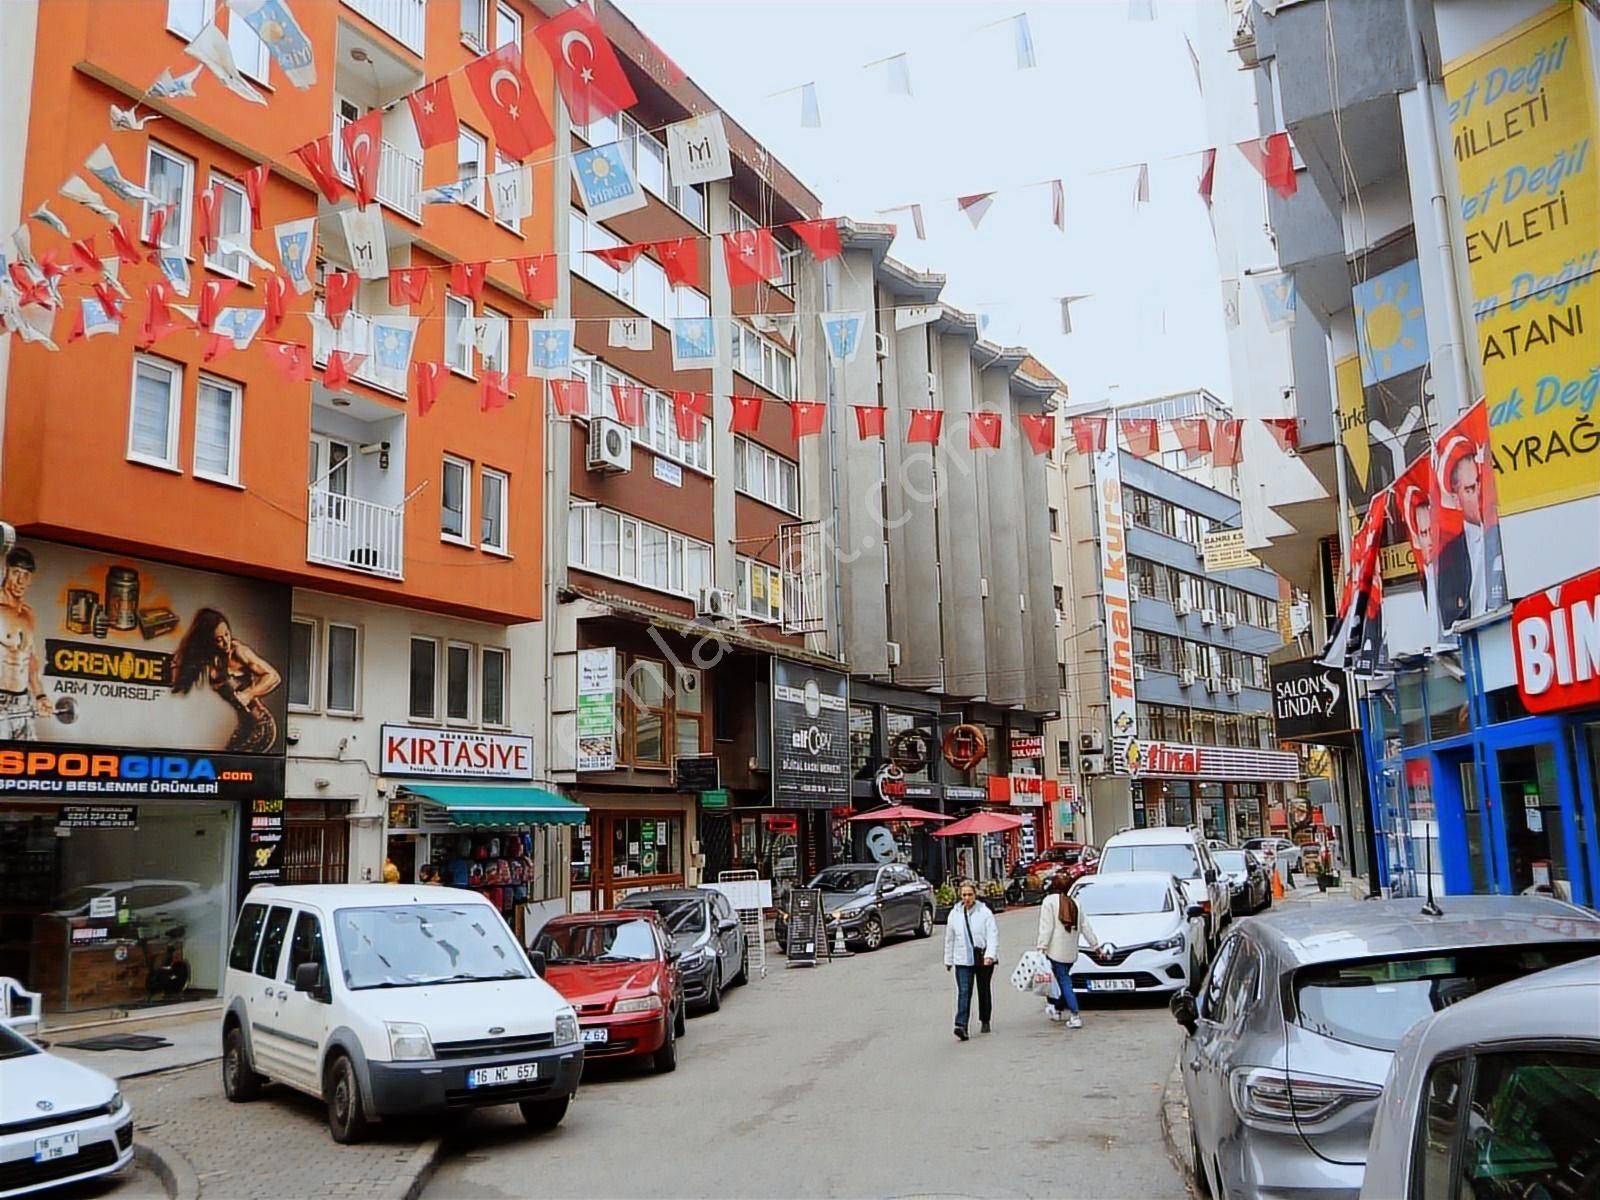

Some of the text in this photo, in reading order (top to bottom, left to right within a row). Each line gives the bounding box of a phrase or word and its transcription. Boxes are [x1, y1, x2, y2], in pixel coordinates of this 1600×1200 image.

[1484, 36, 1568, 105] Değil
[1503, 138, 1588, 204] Değil
[1482, 304, 1584, 366] ATANI
[1103, 478, 1133, 698] final kurs
[1517, 585, 1600, 695] BİM
[54, 680, 162, 702] ARM YOURSELF
[1276, 675, 1320, 700] SALON
[387, 735, 528, 771] KIRTASİYE
[1148, 743, 1202, 774] final
[0, 779, 219, 794] SPORCU BESLENME ÜRÜNLERİ
[1064, 787, 1073, 799] E
[476, 1063, 536, 1084] 16 NC 657
